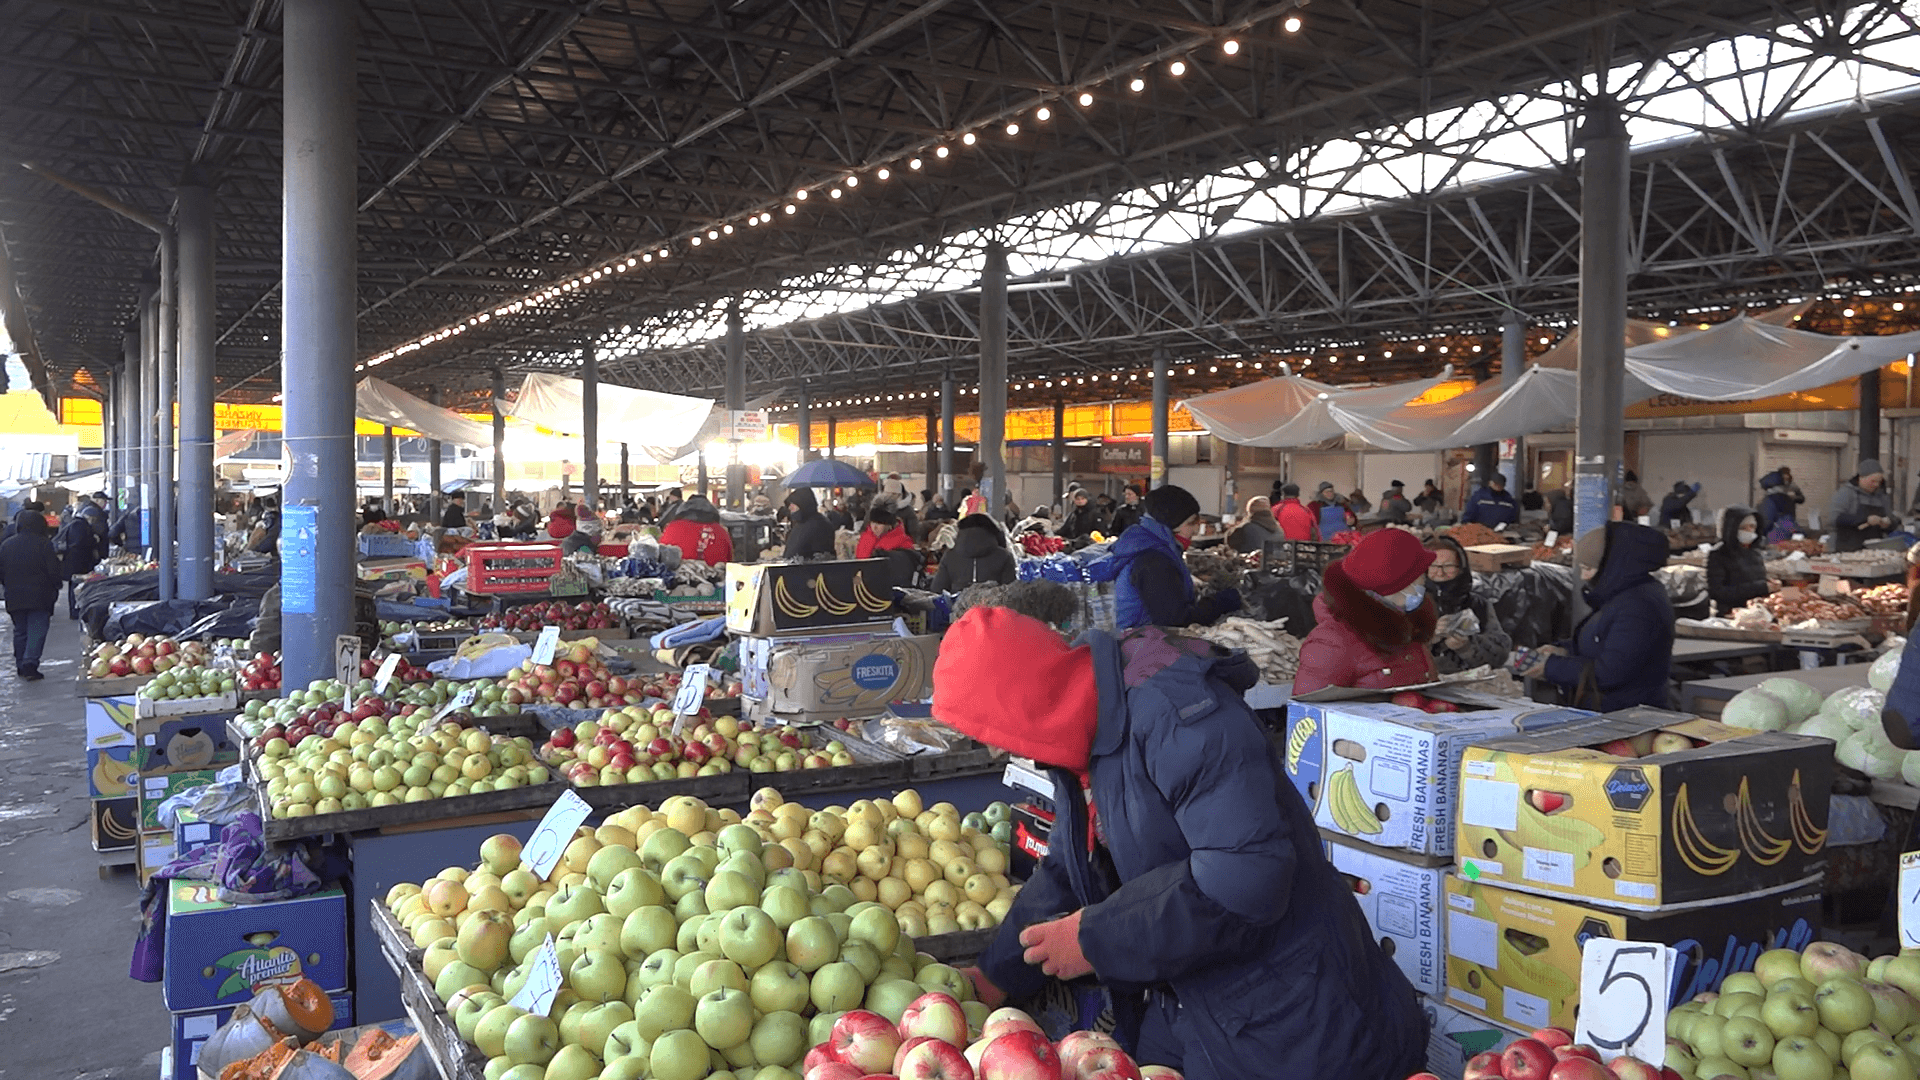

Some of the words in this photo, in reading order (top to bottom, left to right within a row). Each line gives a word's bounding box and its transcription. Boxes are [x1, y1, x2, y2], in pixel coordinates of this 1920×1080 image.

[1103, 448, 1127, 460] Coffee
[1128, 447, 1142, 460] Art
[856, 664, 894, 679] FRESKITA
[1415, 739, 1430, 803] BANANAS
[1436, 740, 1448, 804] BANANAS
[1411, 806, 1425, 850] FRESH
[1435, 808, 1446, 851] FRESH
[1420, 873, 1432, 938] BANANAS
[236, 951, 296, 979] Atlantis
[250, 963, 291, 985] premier
[1420, 940, 1432, 985] FRESH
[1586, 946, 1658, 1050] 5
